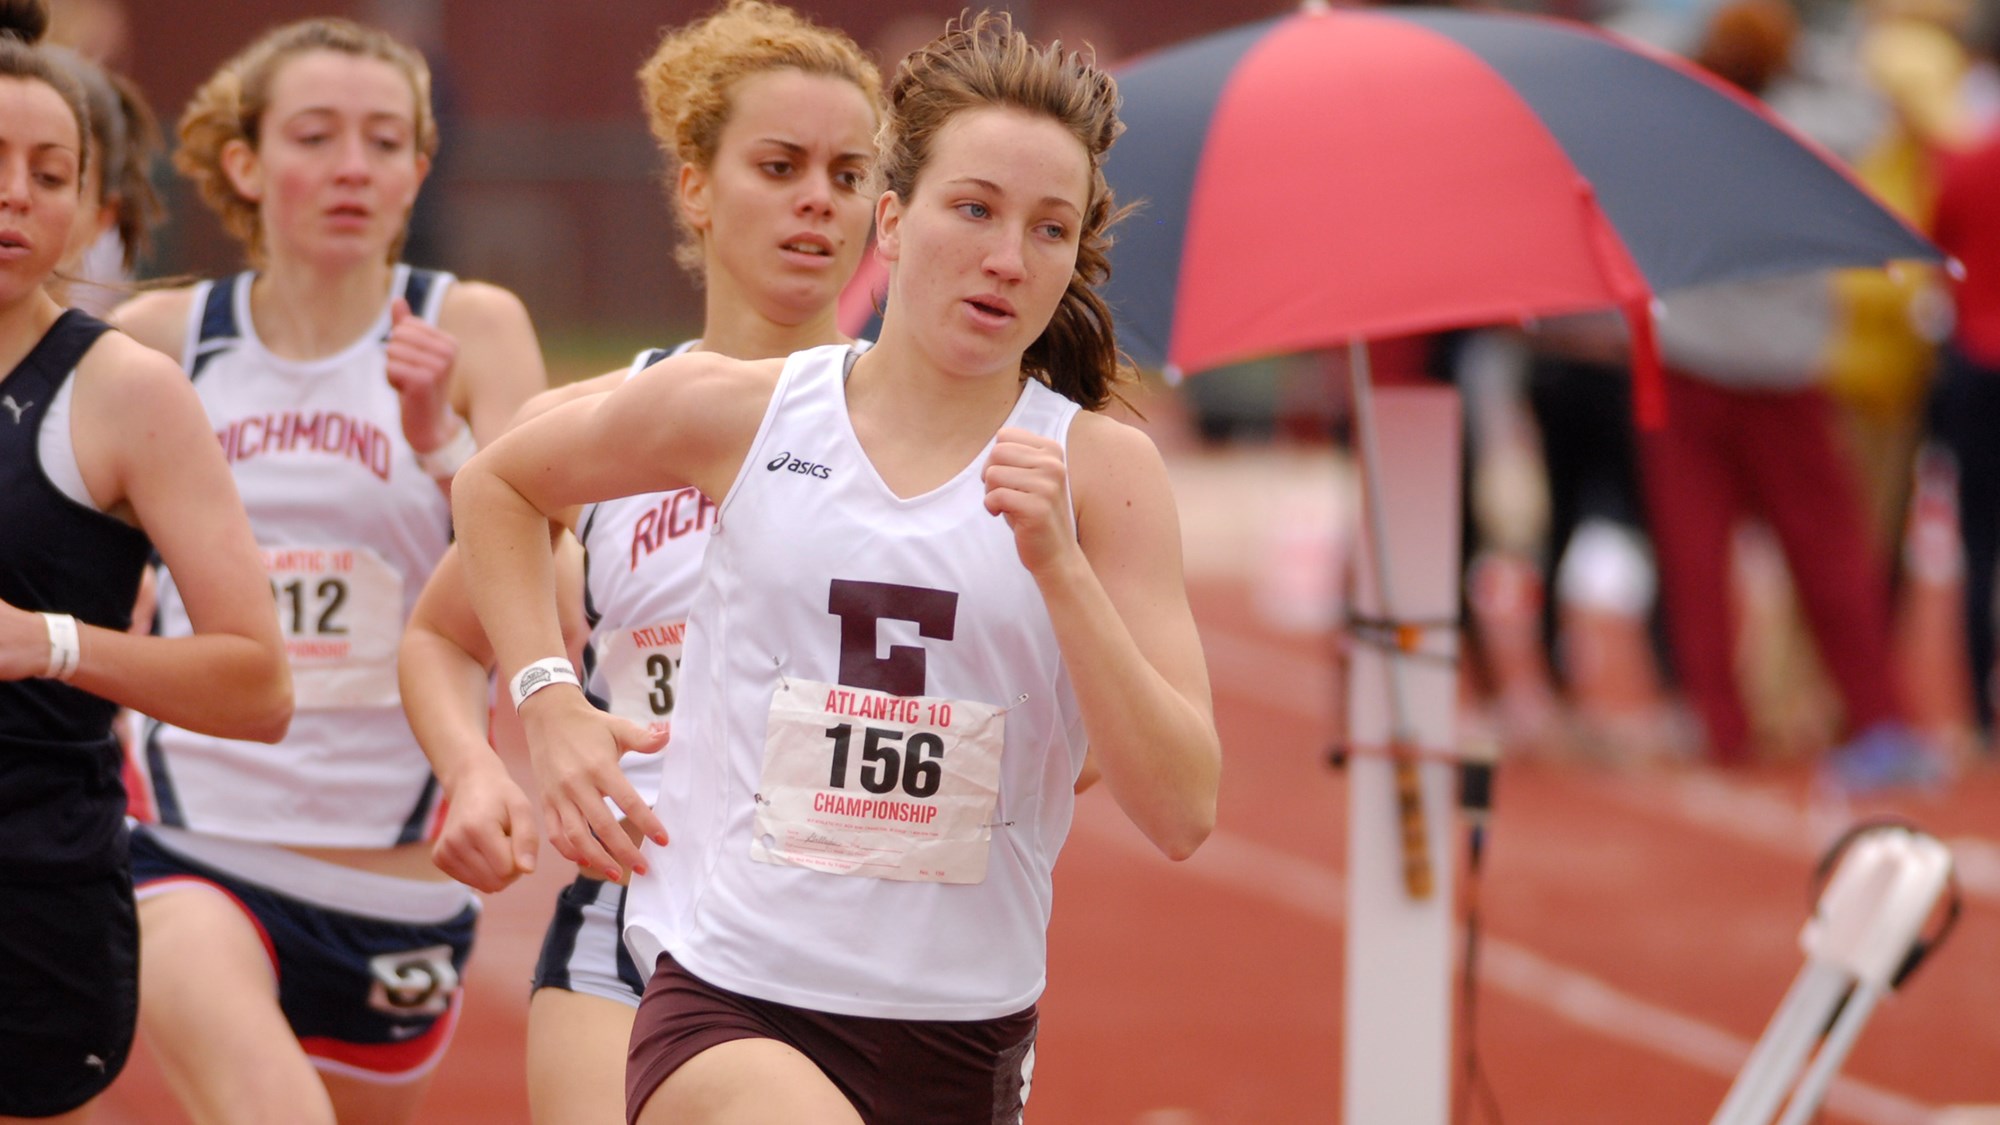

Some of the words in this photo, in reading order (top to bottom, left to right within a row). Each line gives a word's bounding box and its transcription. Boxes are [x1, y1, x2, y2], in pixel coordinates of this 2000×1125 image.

[787, 459, 832, 479] asics
[270, 578, 349, 634] 12
[646, 654, 682, 716] 3
[824, 690, 919, 724] ATLANTIC
[927, 703, 952, 727] 10
[825, 723, 944, 798] 156
[814, 793, 938, 824] CHAMPIONSHIP
